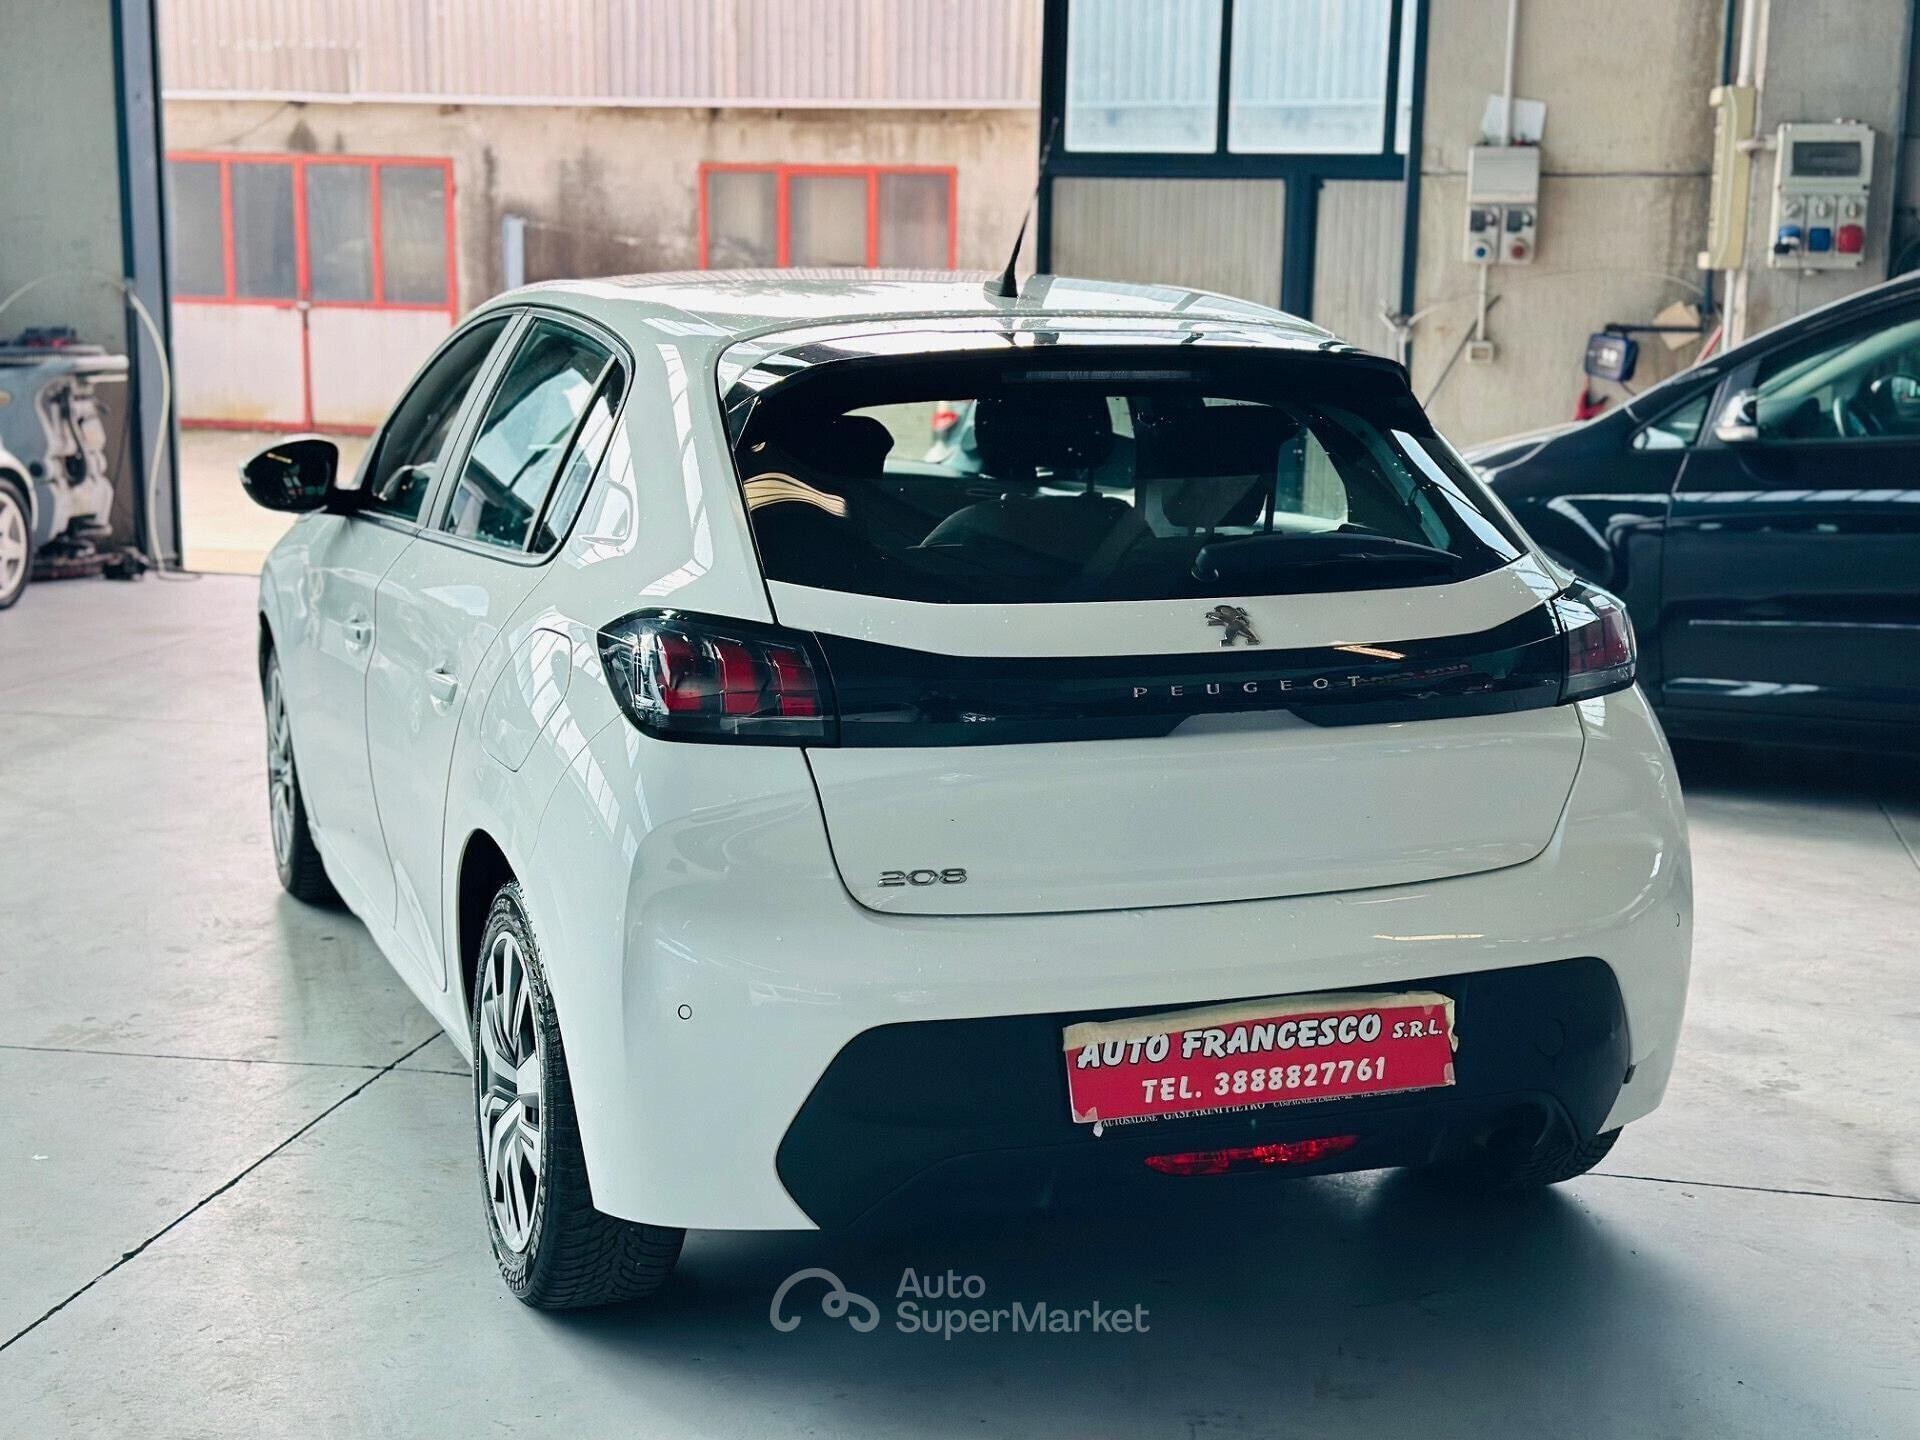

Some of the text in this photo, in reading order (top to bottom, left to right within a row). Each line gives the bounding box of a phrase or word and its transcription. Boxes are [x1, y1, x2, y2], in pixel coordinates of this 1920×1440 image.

[1133, 675, 1361, 699] PEUGEOT
[878, 868, 967, 887] 208
[1077, 1013, 1443, 1069] AUTO FRANCESCO S.R.L.
[1142, 1056, 1385, 1103] TEL. 3888827761
